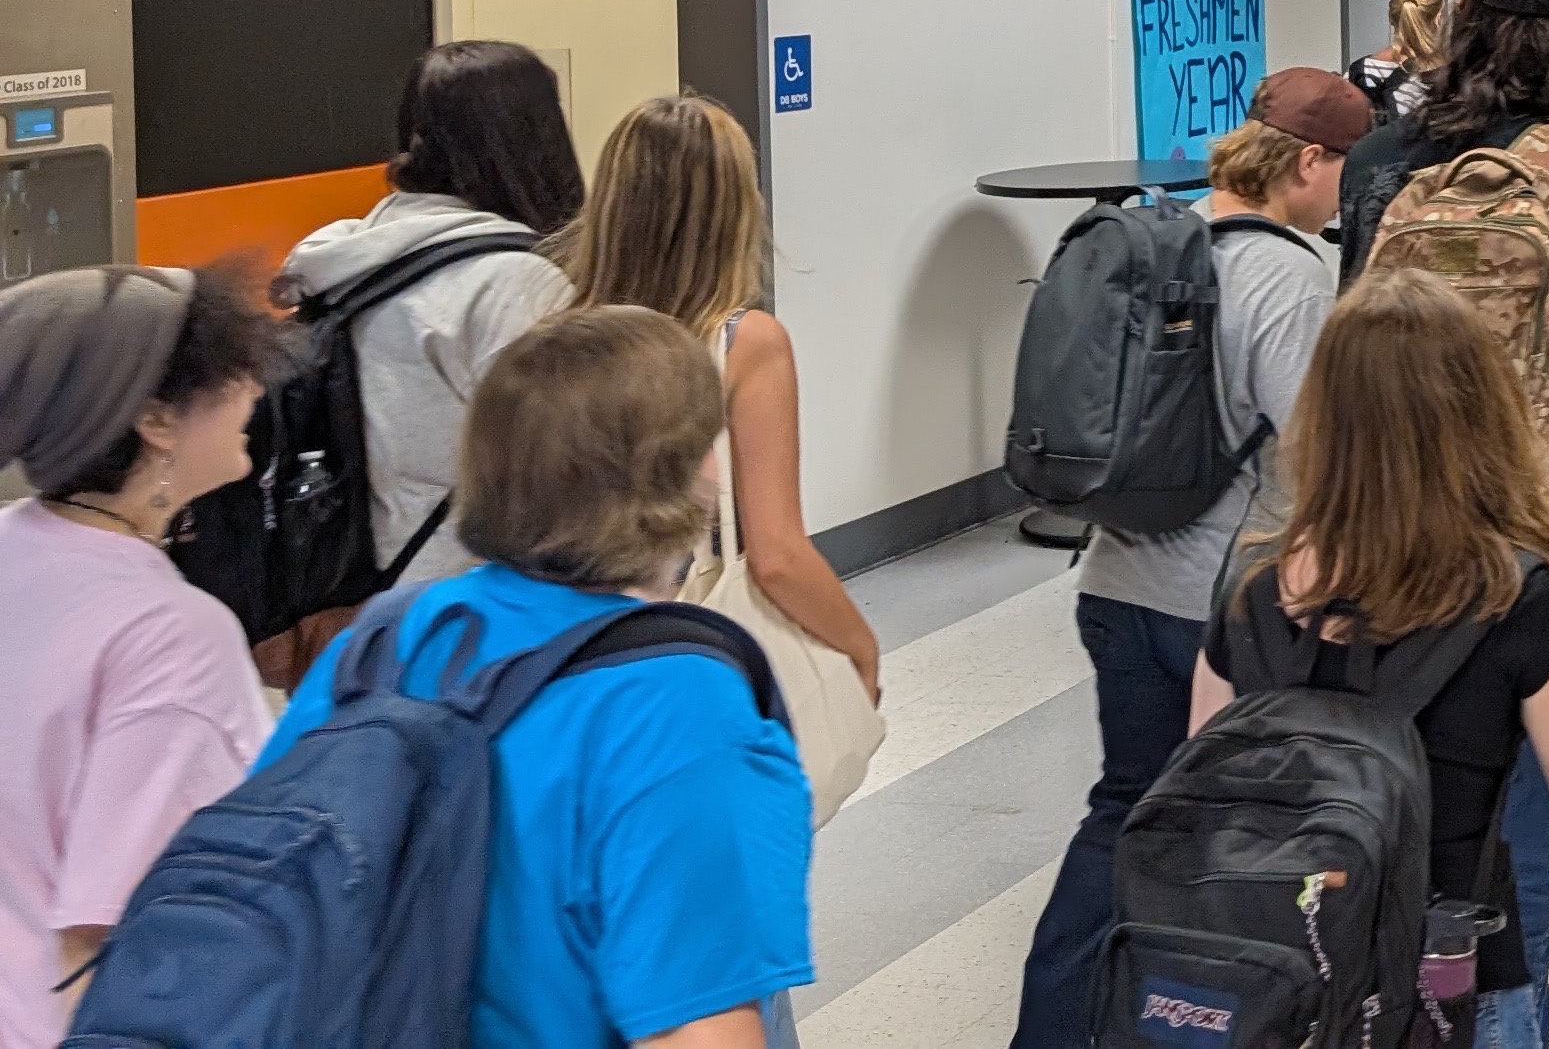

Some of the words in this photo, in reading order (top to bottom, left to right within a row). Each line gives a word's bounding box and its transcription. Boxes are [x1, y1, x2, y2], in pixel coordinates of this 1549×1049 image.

[4, 80, 35, 93] Class
[37, 77, 50, 90] of
[52, 74, 82, 89] 2018
[1168, 50, 1249, 139] YEAR
